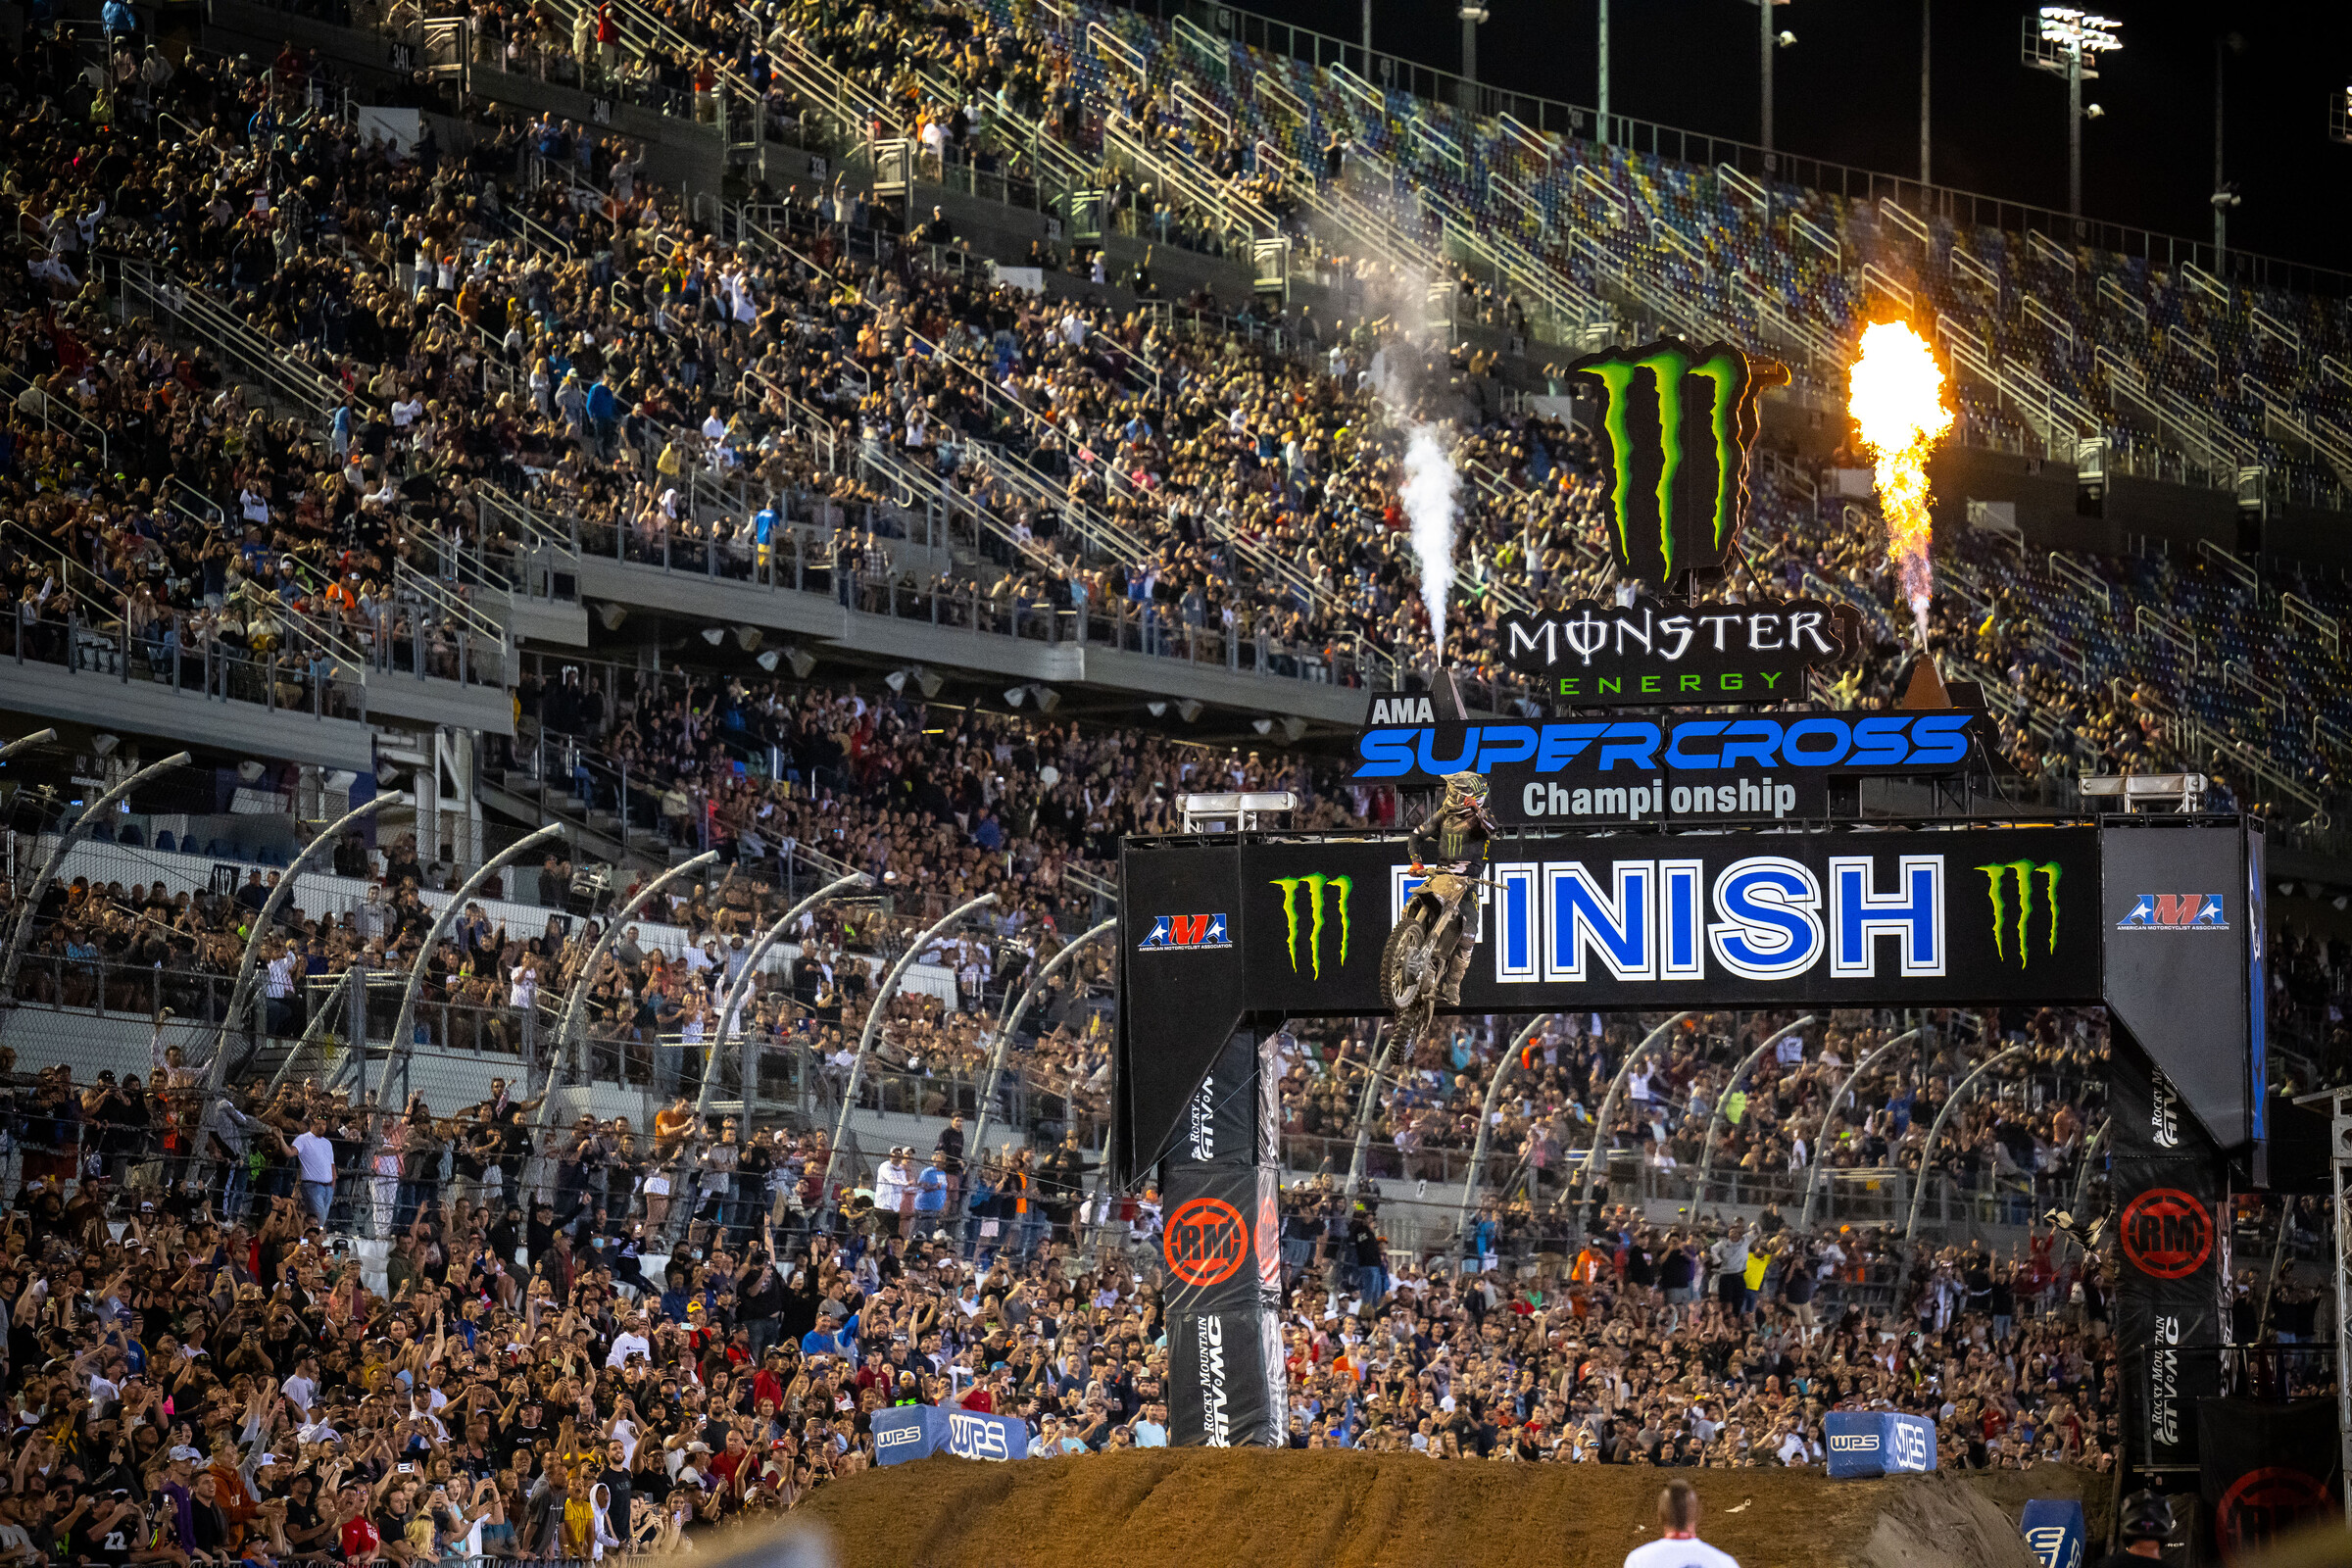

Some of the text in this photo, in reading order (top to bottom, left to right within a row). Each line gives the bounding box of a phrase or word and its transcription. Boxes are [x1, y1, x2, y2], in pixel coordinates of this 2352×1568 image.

[393, 43, 410, 71] 341
[1508, 608, 1835, 665] MONSTER
[1560, 671, 1783, 695] ENERGY
[1371, 697, 1435, 725] AMA
[1351, 715, 1974, 778] SUPERCROSS
[1523, 778, 1796, 820] Championship
[2116, 894, 2230, 925] AMA
[1138, 912, 1233, 947] AMA
[1180, 1223, 1231, 1261] RM
[2138, 1214, 2196, 1252] RM
[877, 1425, 921, 1447] WPS
[949, 1413, 1008, 1462] WPS
[1830, 1434, 1880, 1451] WPS
